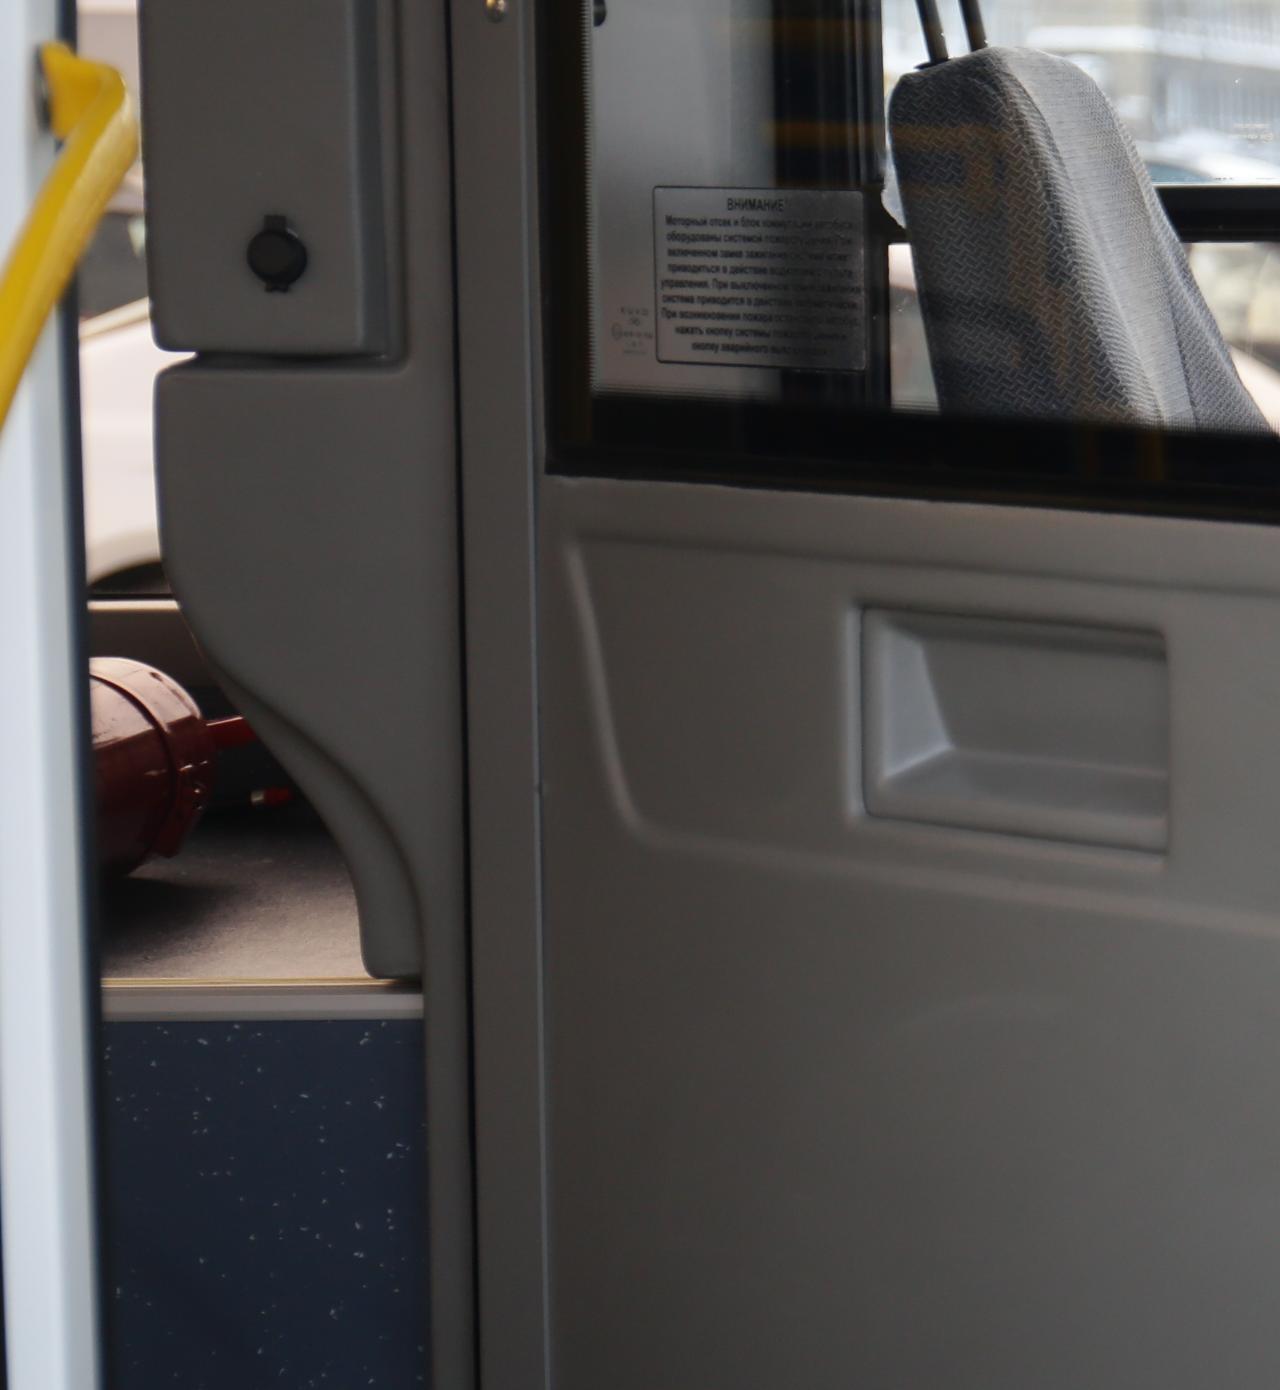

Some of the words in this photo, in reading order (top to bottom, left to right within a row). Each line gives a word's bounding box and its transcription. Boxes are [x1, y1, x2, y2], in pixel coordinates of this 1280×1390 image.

[664, 215, 707, 229] Моторный
[741, 217, 760, 228] блок
[666, 232, 721, 245] оборудованы
[712, 279, 728, 291] При
